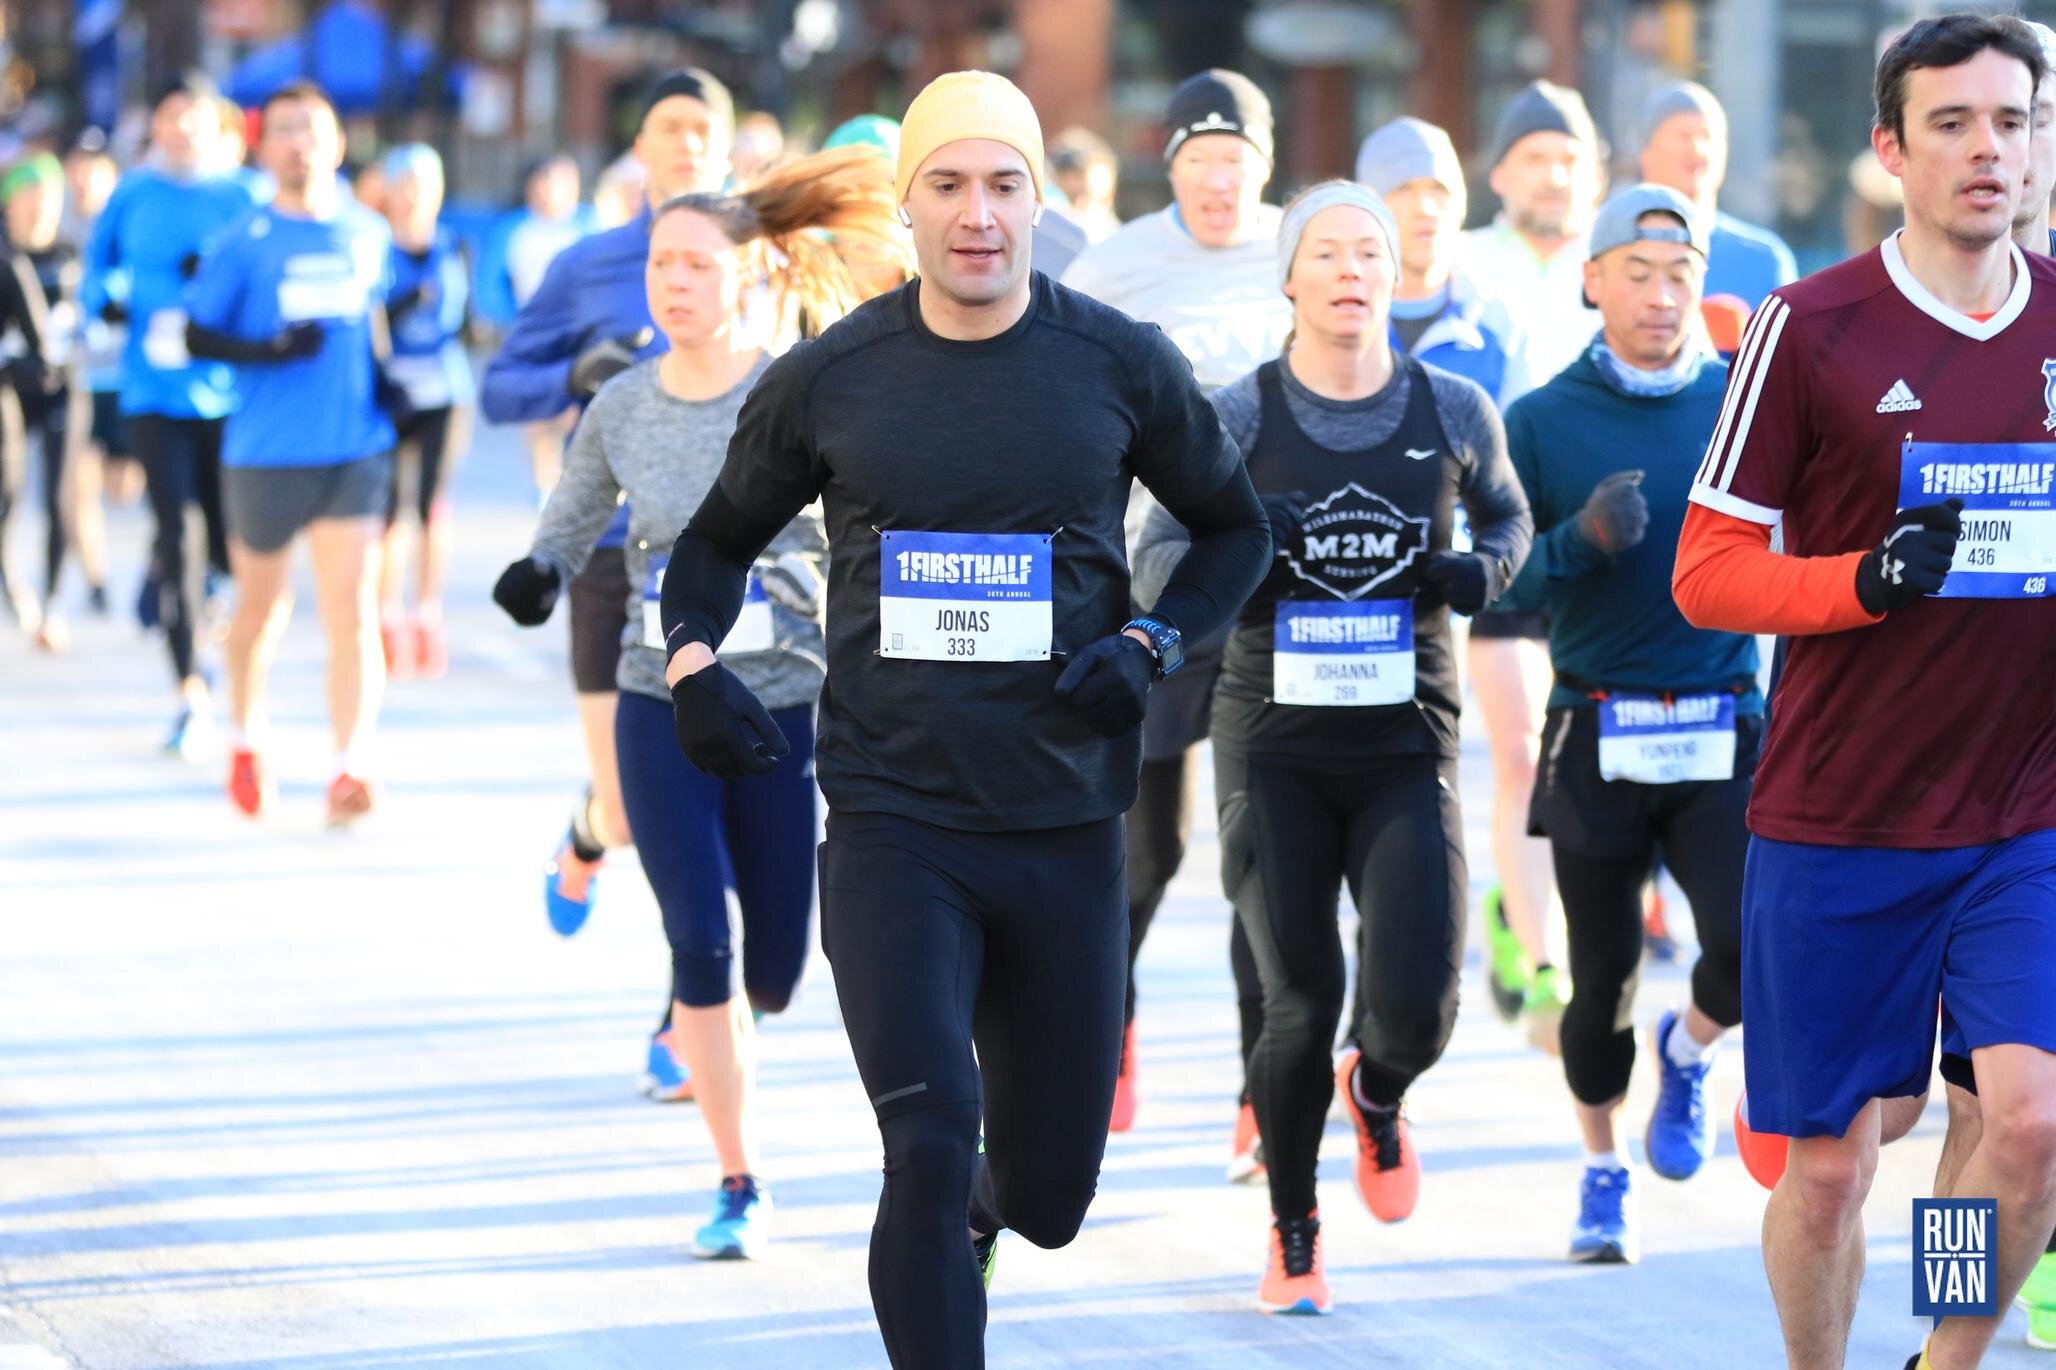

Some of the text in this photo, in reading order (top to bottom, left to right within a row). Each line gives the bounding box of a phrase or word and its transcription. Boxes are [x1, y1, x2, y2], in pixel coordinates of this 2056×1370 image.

[1876, 399, 1922, 413] adidas
[1920, 463, 2055, 494] 1FIRSTHALF
[1958, 520, 2012, 542] SIMON
[1303, 533, 1399, 561] M2M
[1967, 548, 1995, 566] 436
[897, 551, 1032, 584] 1FIRSTHALF
[2023, 577, 2047, 593] 436
[936, 610, 990, 632] JONAS
[947, 638, 976, 656] 333
[1314, 663, 1379, 680] JOHANNA
